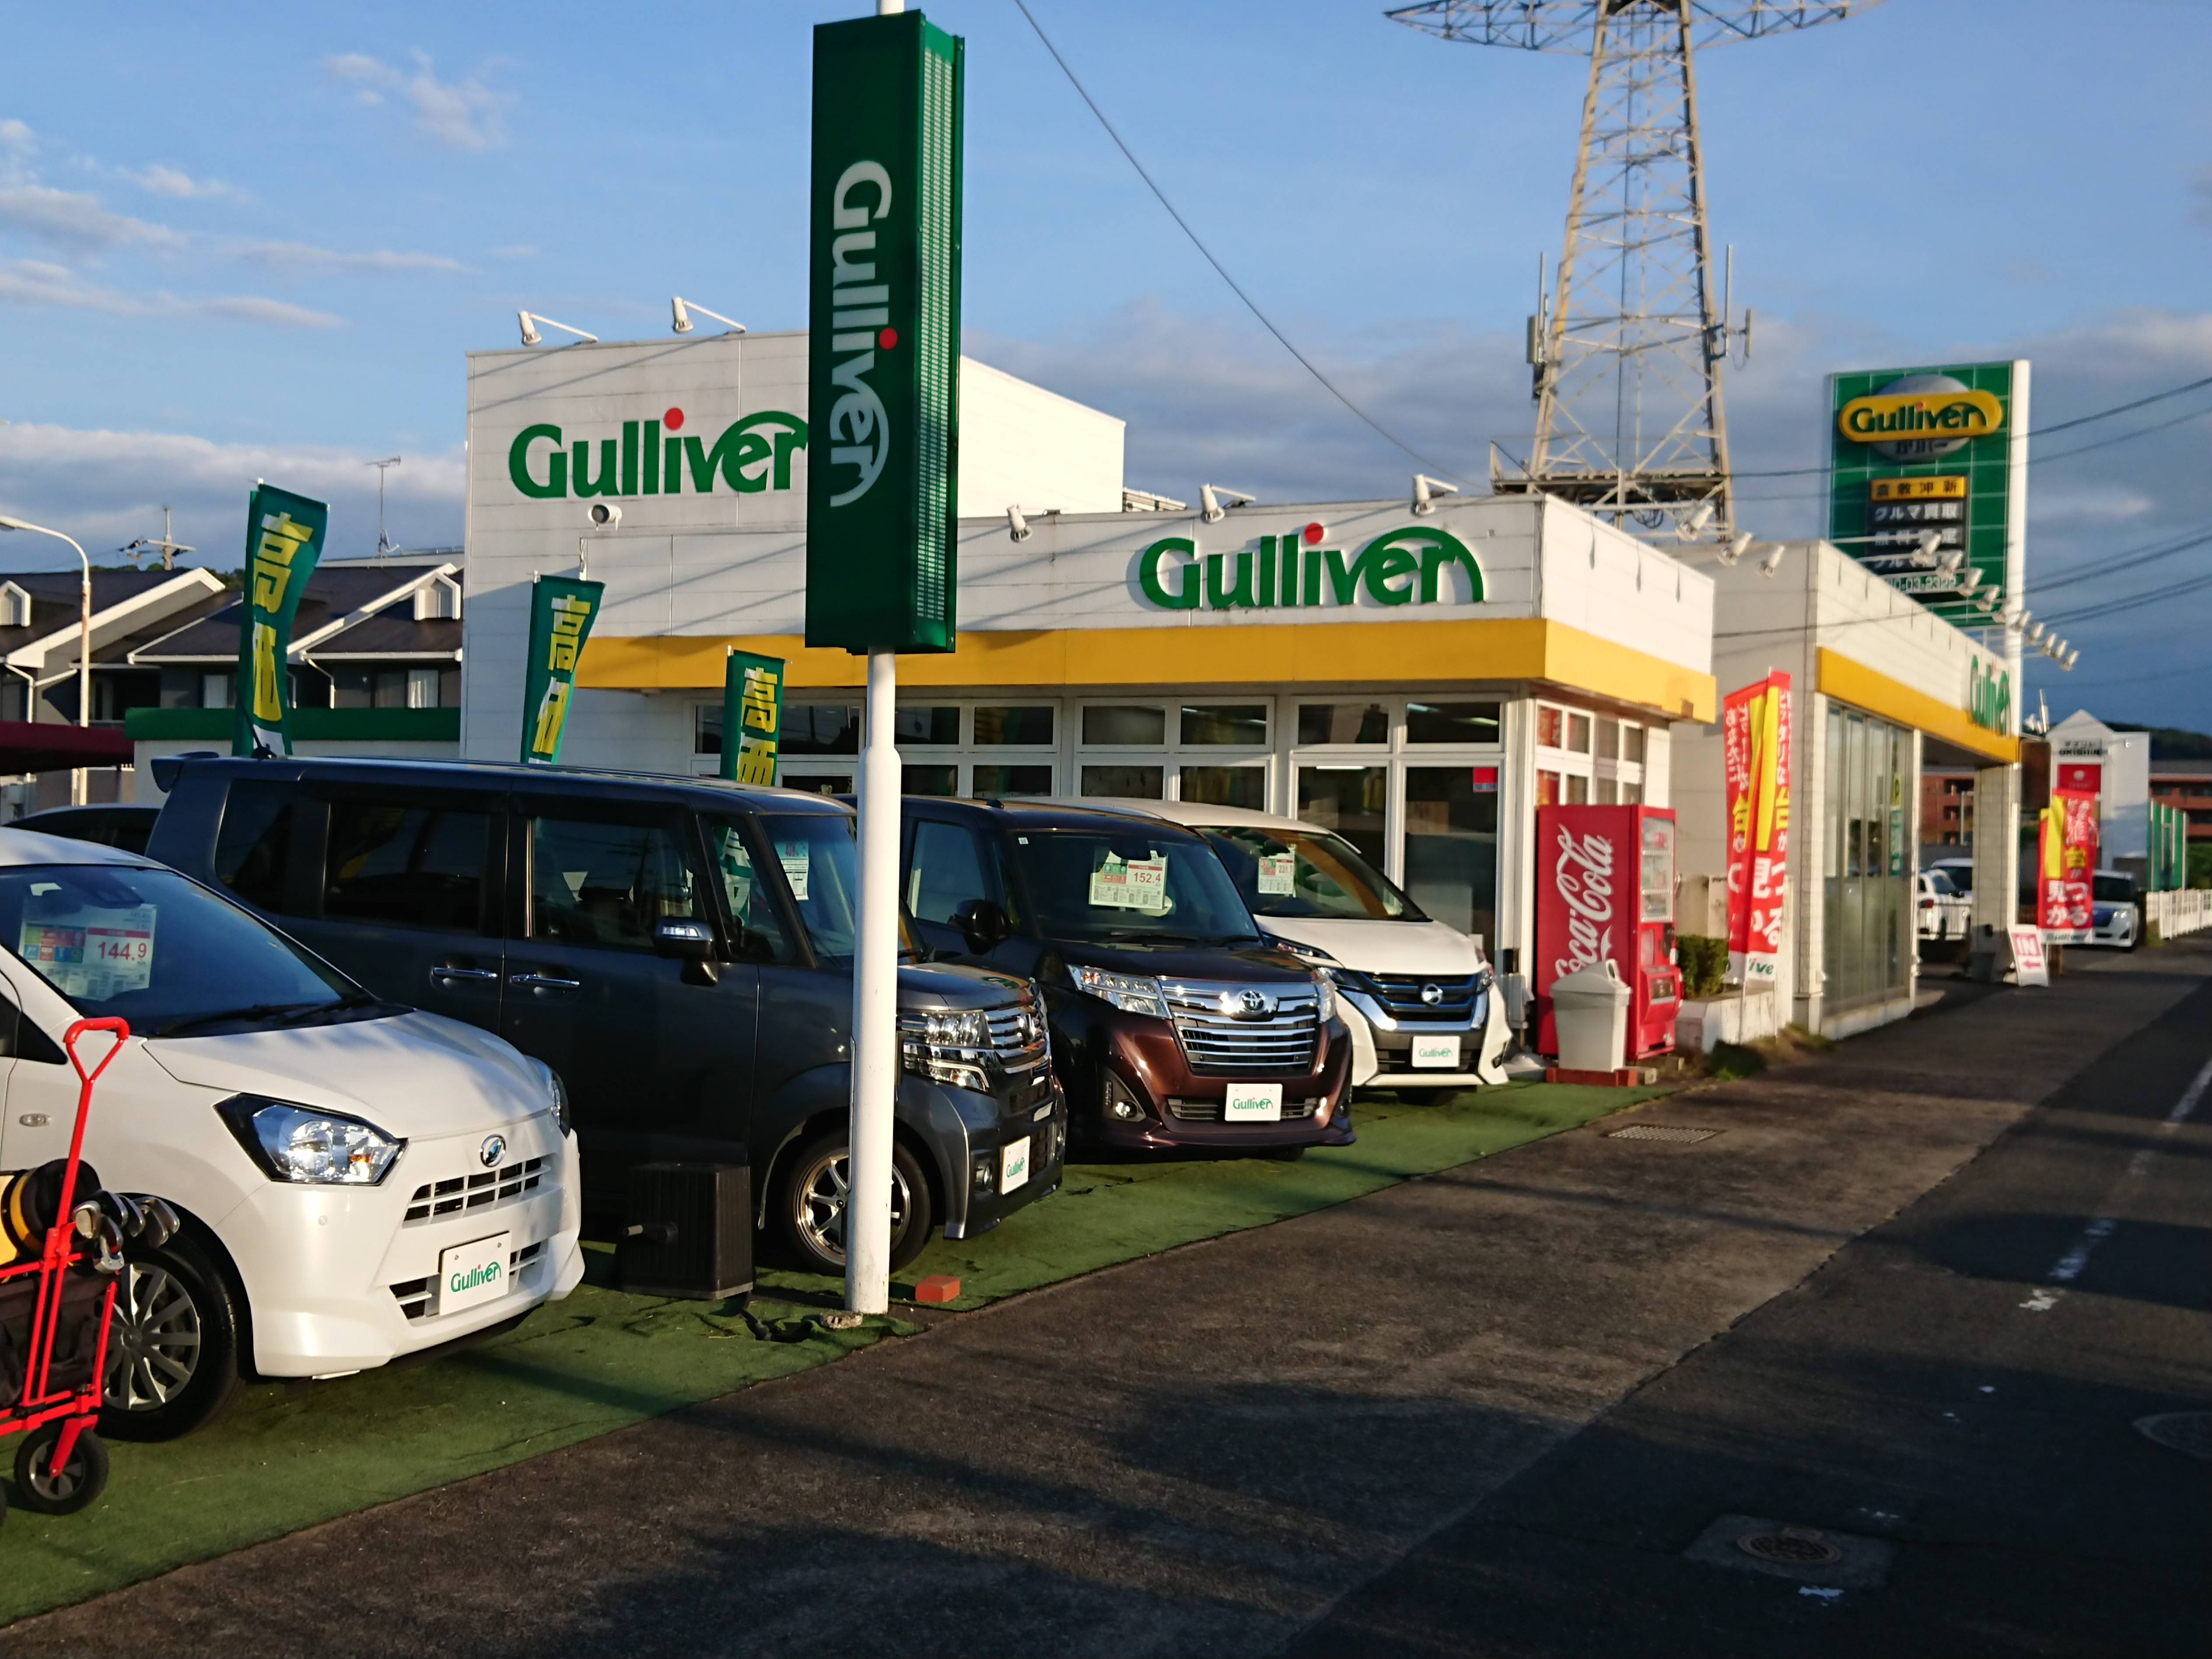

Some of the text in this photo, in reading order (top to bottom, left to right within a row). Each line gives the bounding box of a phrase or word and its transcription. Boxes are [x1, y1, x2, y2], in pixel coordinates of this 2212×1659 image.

[829, 160, 898, 508] Gulliver
[1850, 401, 1987, 433] Gulliver
[508, 407, 808, 498] Gulliver
[1139, 523, 1484, 610] Gulliver
[1134, 872, 1162, 883] 152.4
[98, 941, 147, 961] 144.9
[2016, 937, 2037, 955] IN
[1419, 1047, 1453, 1057] Gulliver
[1232, 1097, 1273, 1110] Gulliver
[451, 1261, 502, 1292] Gulliver
